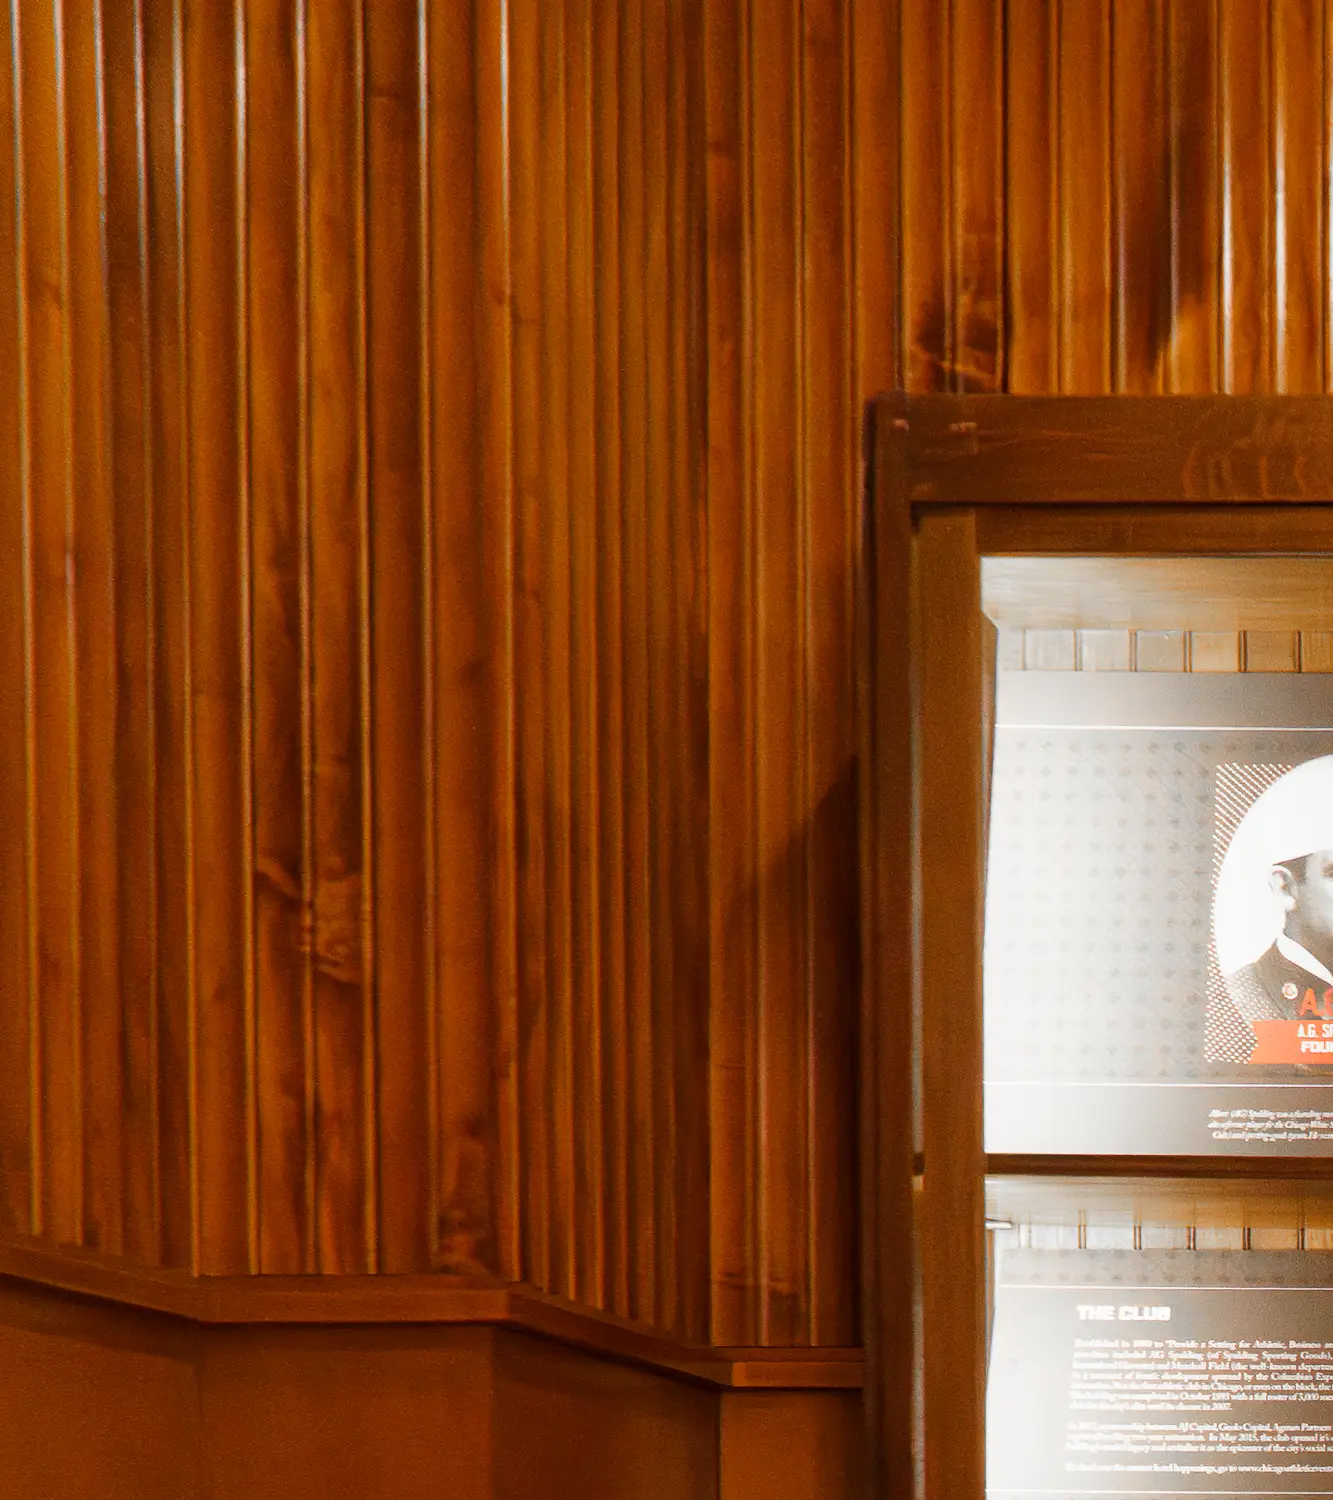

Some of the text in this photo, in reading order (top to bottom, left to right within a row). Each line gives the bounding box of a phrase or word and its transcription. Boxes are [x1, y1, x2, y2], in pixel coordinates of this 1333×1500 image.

[1297, 1024, 1318, 1038] A.G.
[1076, 1305, 1171, 1321] THE CLUB
